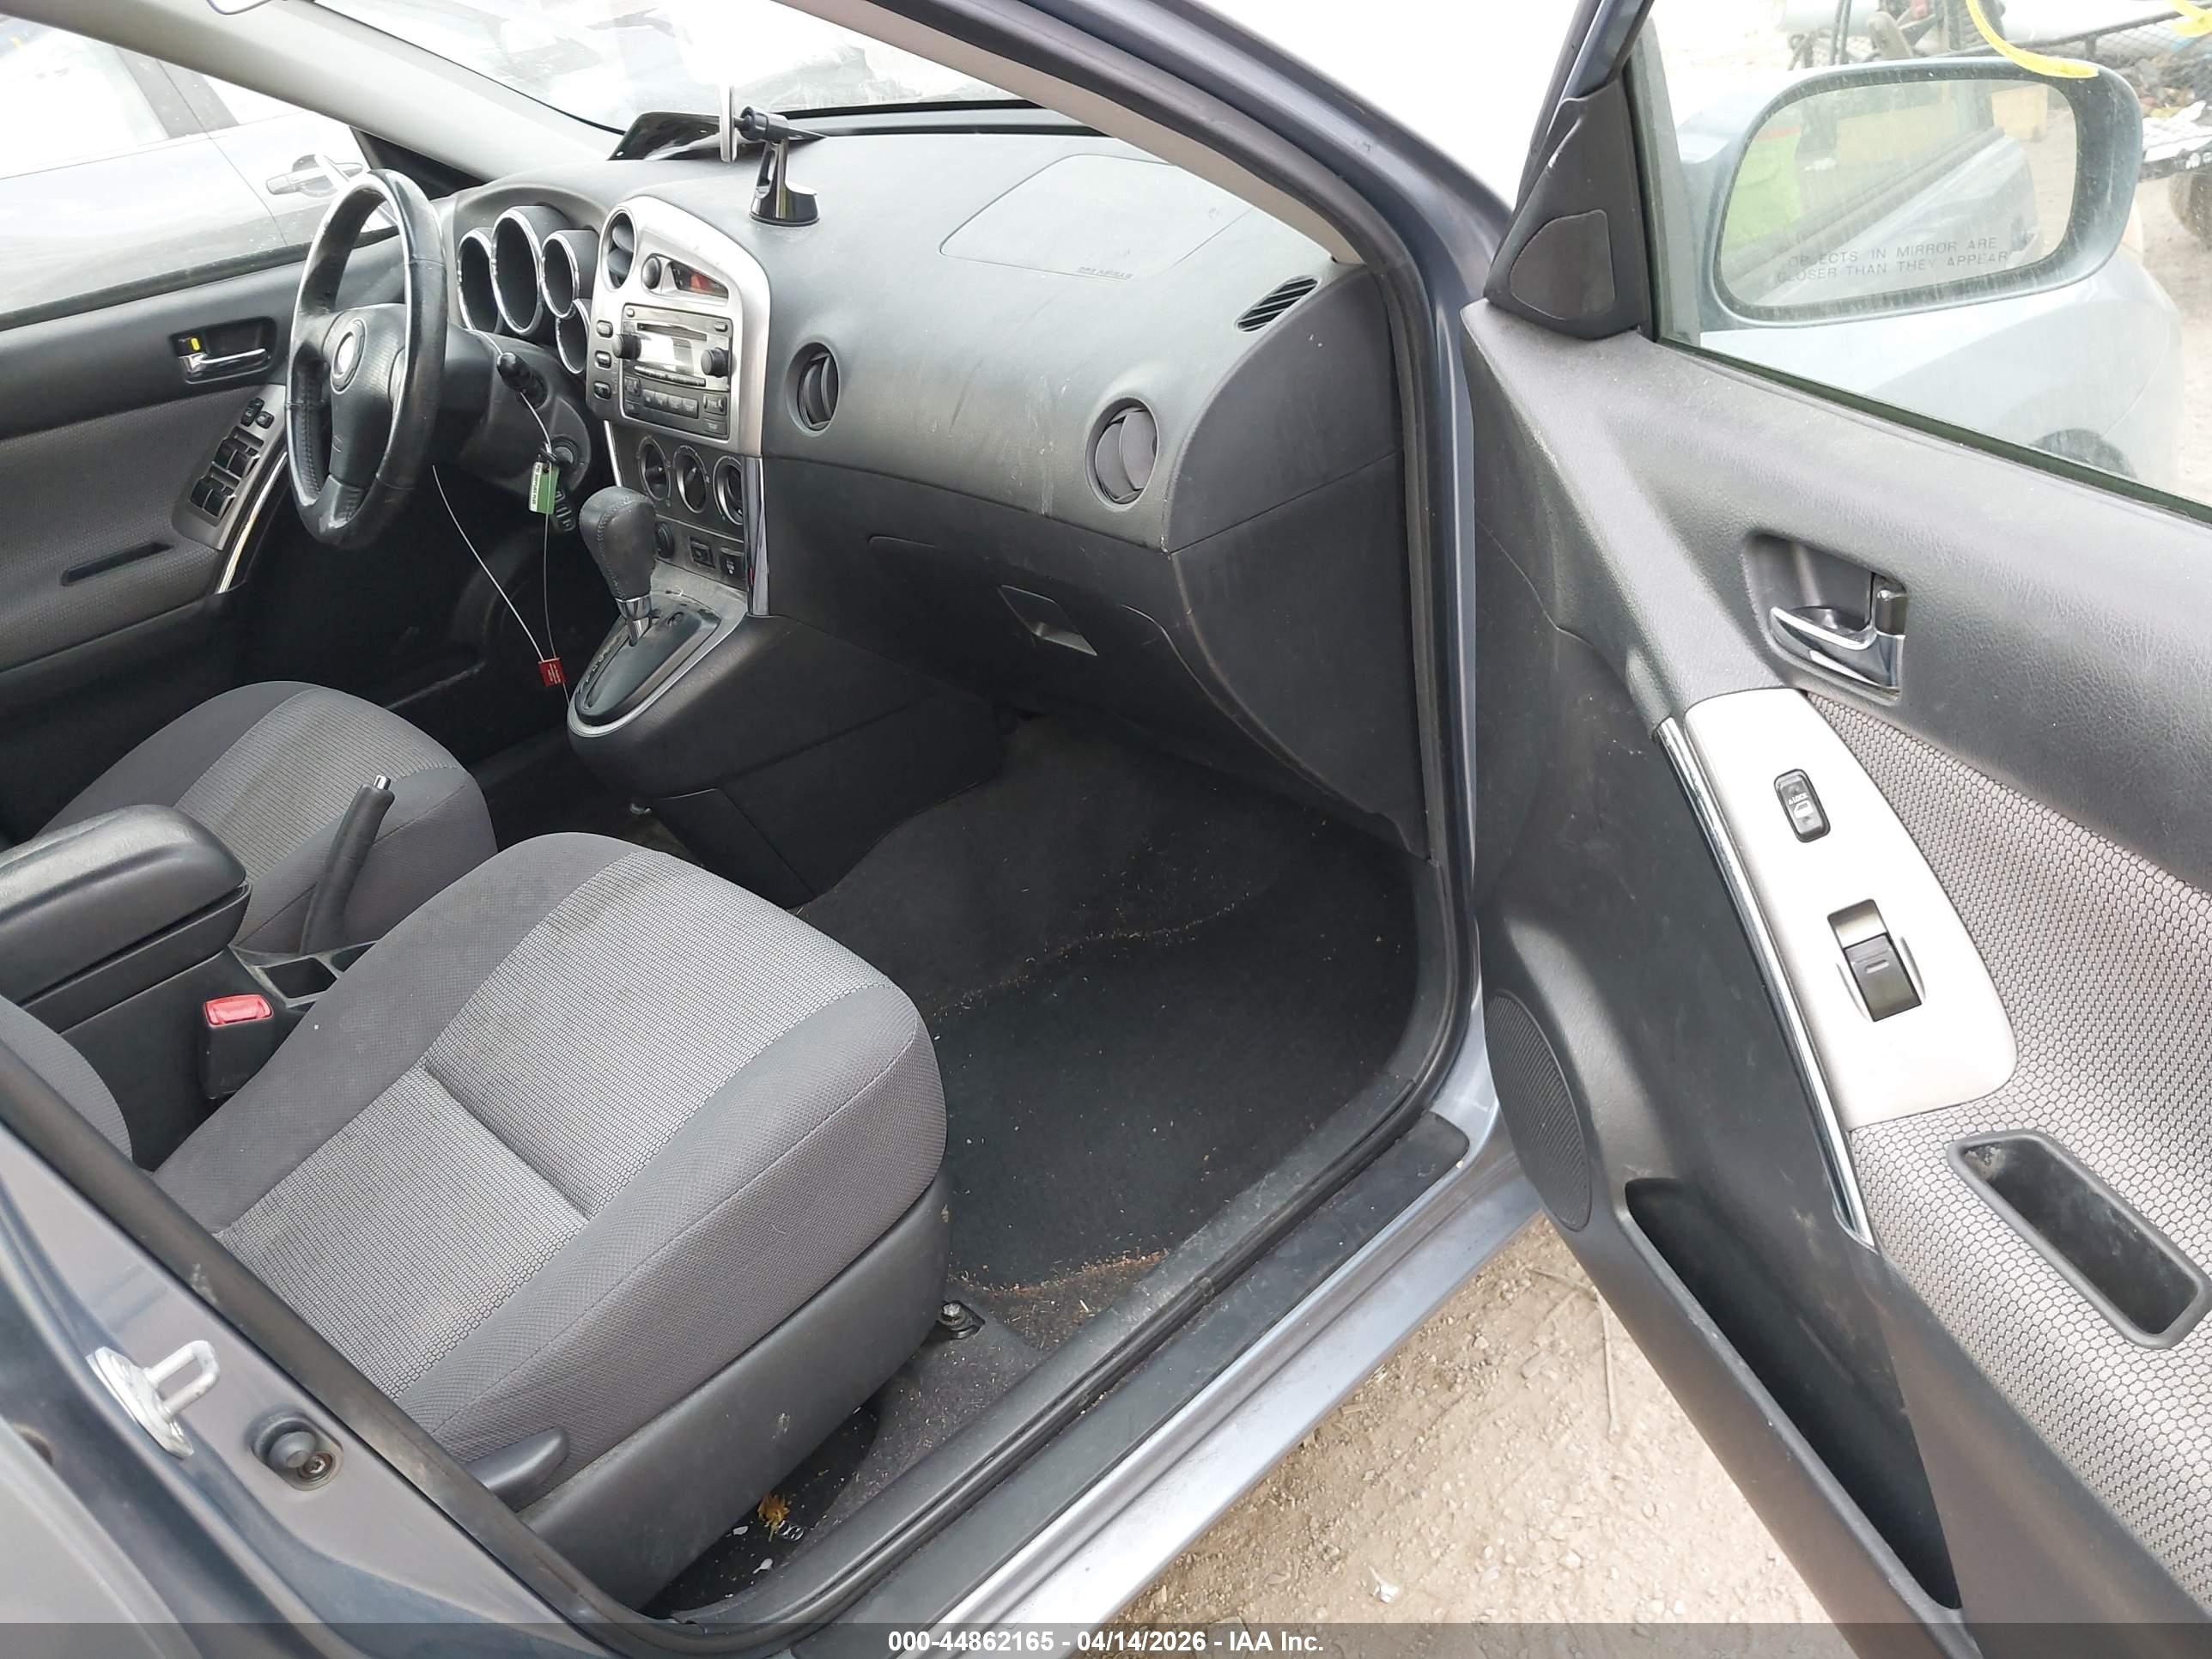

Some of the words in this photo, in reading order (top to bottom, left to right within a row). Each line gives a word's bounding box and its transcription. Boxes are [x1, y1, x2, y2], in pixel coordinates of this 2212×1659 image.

[1778, 266, 1837, 283] CLOSER
[1846, 263, 1887, 276] THAN
[1897, 259, 1936, 272] THEY
[1947, 251, 2008, 266] APPEAR
[1787, 250, 1859, 267] OBJECTS
[1871, 248, 1887, 260] IN
[1896, 241, 1958, 258] MIRROR
[1967, 236, 1997, 250] ARE
